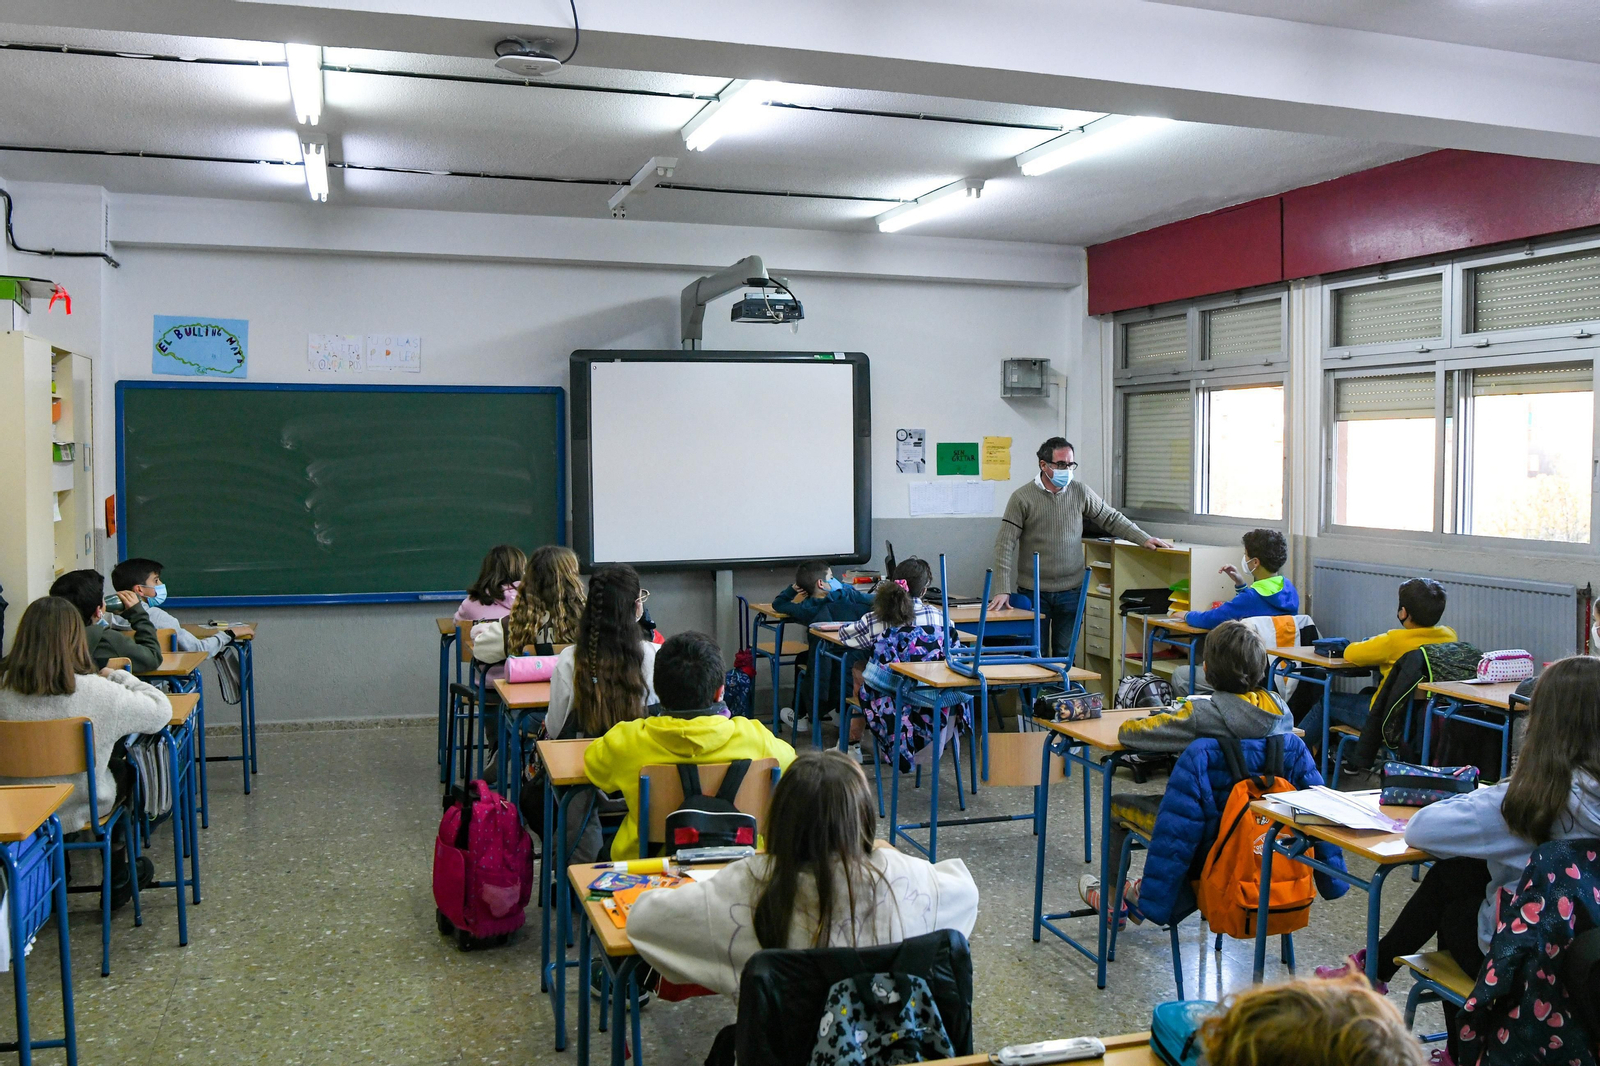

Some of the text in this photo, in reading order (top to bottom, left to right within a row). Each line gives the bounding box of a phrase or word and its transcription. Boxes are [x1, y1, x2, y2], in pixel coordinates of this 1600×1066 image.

[158, 339, 173, 353] EL
[173, 326, 222, 340] BULLING
[396, 337, 419, 348] LAS
